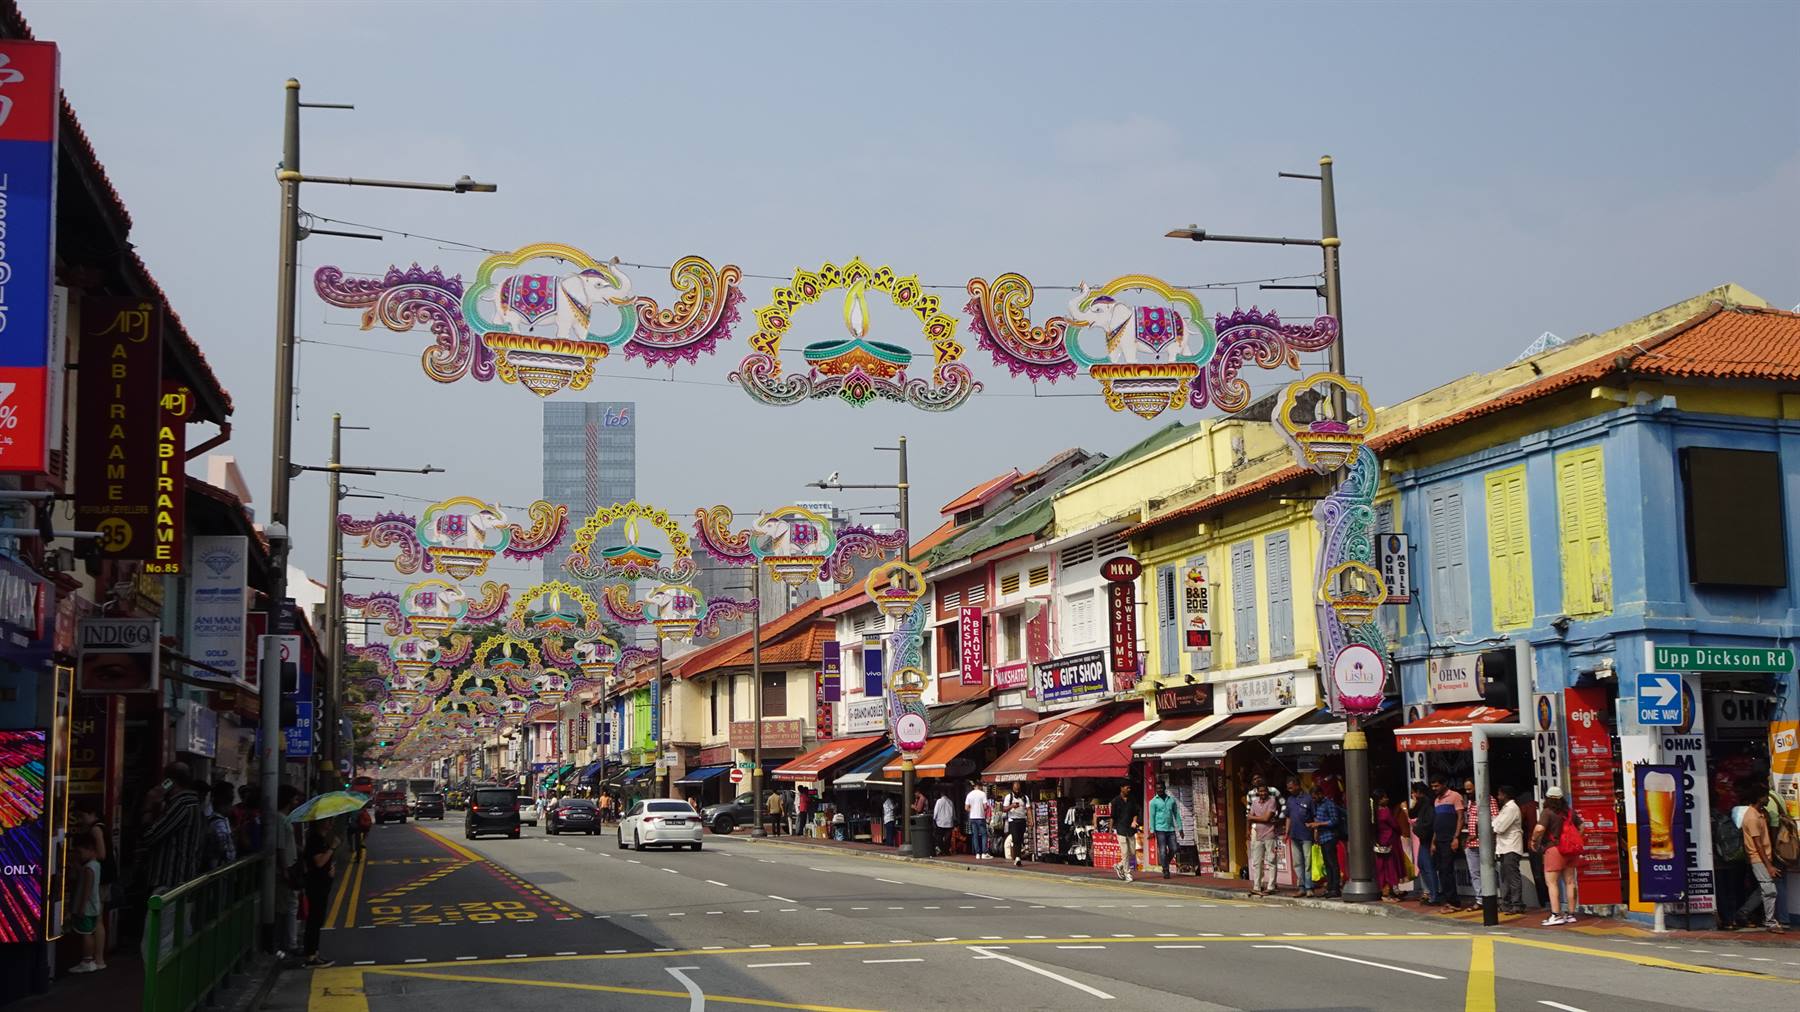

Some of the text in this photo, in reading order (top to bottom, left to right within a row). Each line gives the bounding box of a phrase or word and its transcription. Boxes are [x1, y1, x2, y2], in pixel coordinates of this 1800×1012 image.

[106, 343, 128, 501] ABIRAAME
[156, 426, 176, 560] ABIRAAME
[146, 563, 179, 574] No.85
[1110, 564, 1133, 575] MKM
[1385, 554, 1396, 596] OHMS
[1397, 554, 1406, 596] MOBILE
[1186, 587, 1207, 598] B&B
[1187, 599, 1208, 609] 2012
[1114, 587, 1125, 667] COSTUME
[1125, 587, 1134, 668] JEWELLERY
[963, 608, 973, 680] NAKSHATRA
[973, 620, 981, 668] BEAUTY
[1658, 649, 1786, 667] Upp Dickson Rd
[1043, 670, 1054, 690] SG
[1060, 666, 1078, 687] GIFT
[1079, 661, 1103, 684] SHOP
[1439, 669, 1467, 682] OHMS
[1156, 692, 1177, 710] MKM
[1641, 709, 1679, 721] ONE WAY
[1664, 738, 1703, 751] OHMS
[4, 864, 36, 876] ONLY
[1653, 864, 1673, 872] COLD
